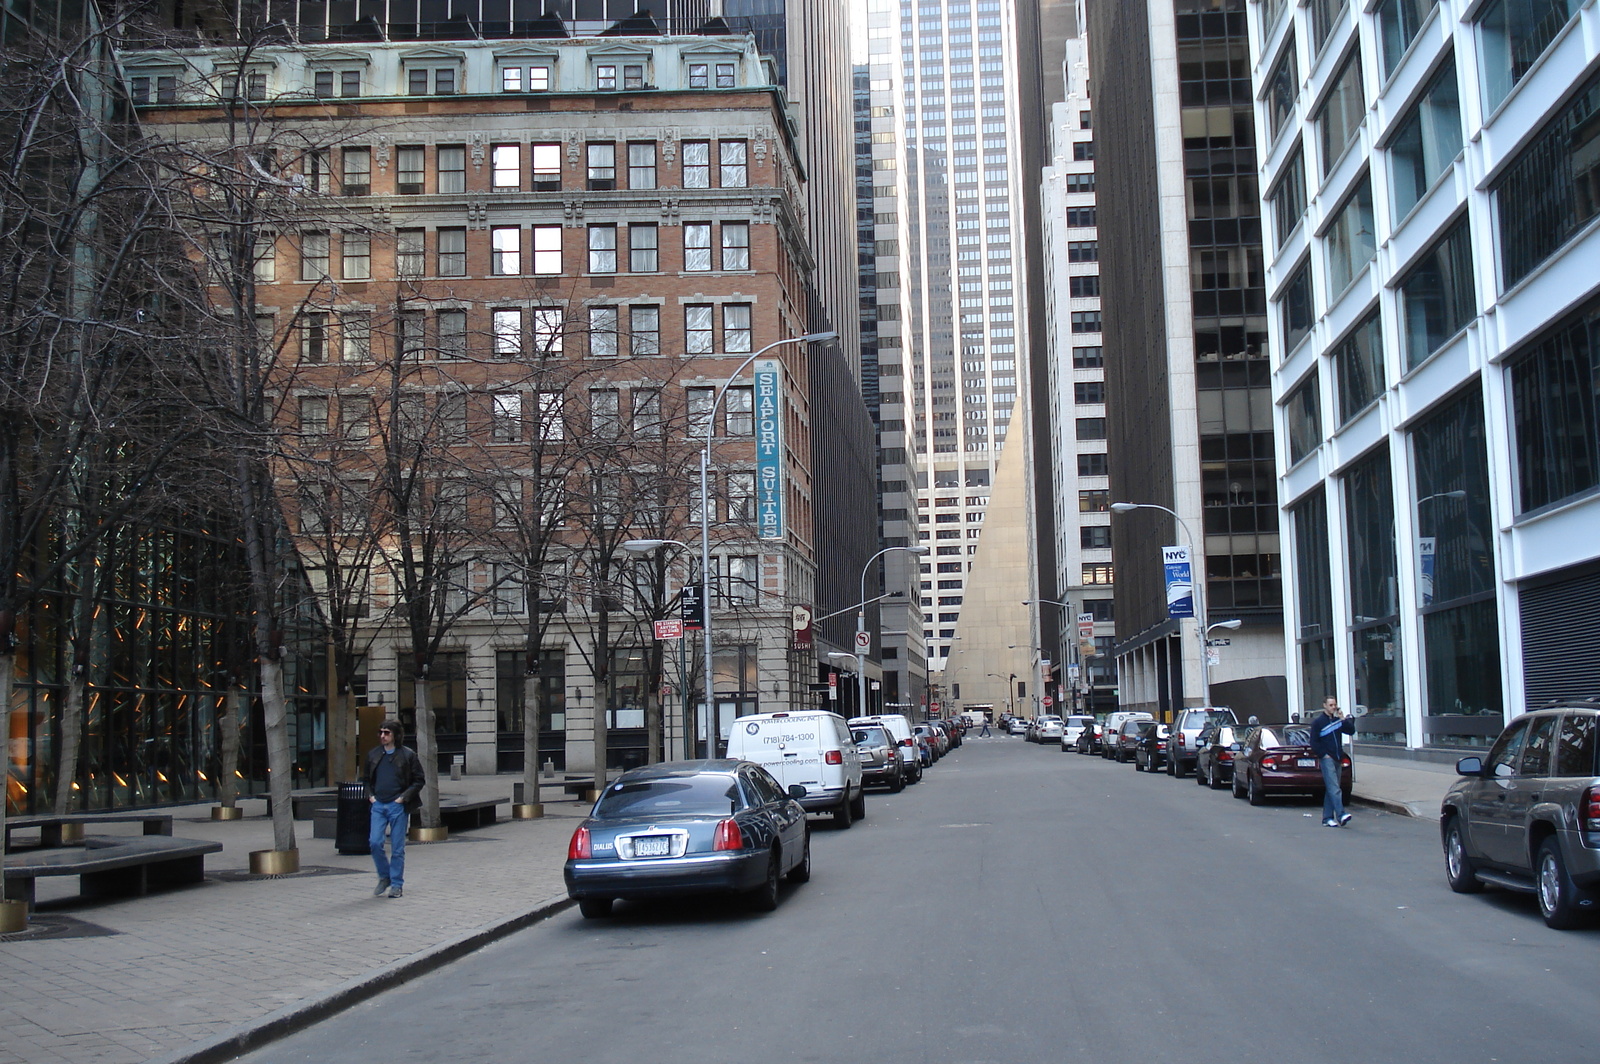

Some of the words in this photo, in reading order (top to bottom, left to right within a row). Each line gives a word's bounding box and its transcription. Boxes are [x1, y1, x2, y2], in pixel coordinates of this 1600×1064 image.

[759, 373, 776, 455] SEAPORT
[761, 466, 778, 539] SUITES
[1165, 550, 1186, 560] NYC
[1172, 570, 1189, 578] World
[763, 736, 780, 744] (718)
[781, 733, 815, 742] 784-1300
[760, 758, 818, 768] powercooling.com
